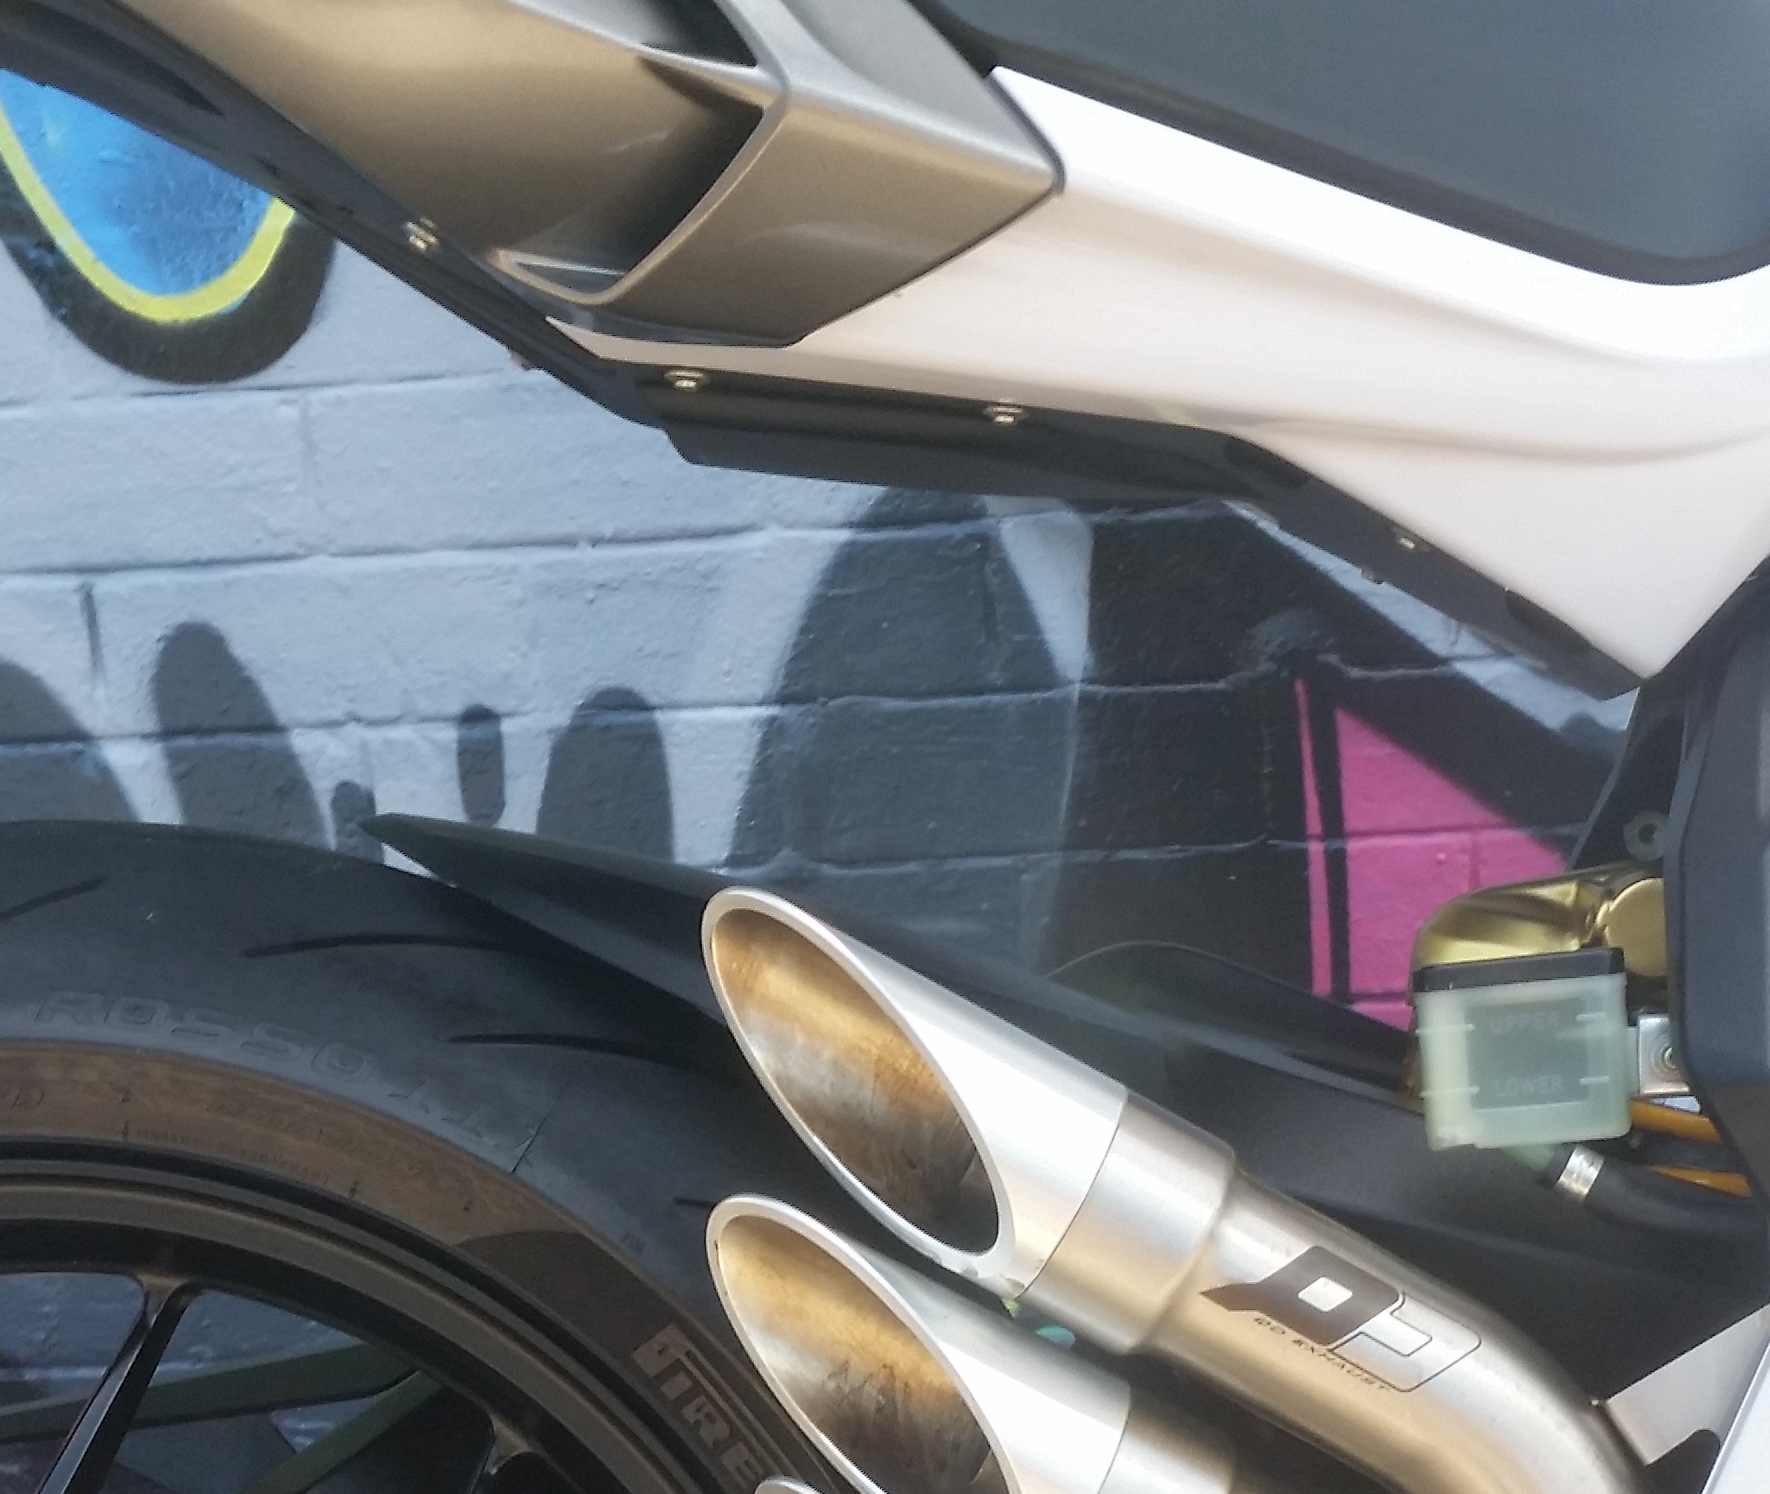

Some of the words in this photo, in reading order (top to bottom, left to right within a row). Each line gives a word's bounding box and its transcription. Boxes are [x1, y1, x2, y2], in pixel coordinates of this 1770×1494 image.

[33, 990, 379, 1084] ROSSO
[1489, 1010, 1561, 1036] UPPER
[1494, 1073, 1564, 1097] LOWER
[630, 1322, 789, 1491] PIRE
